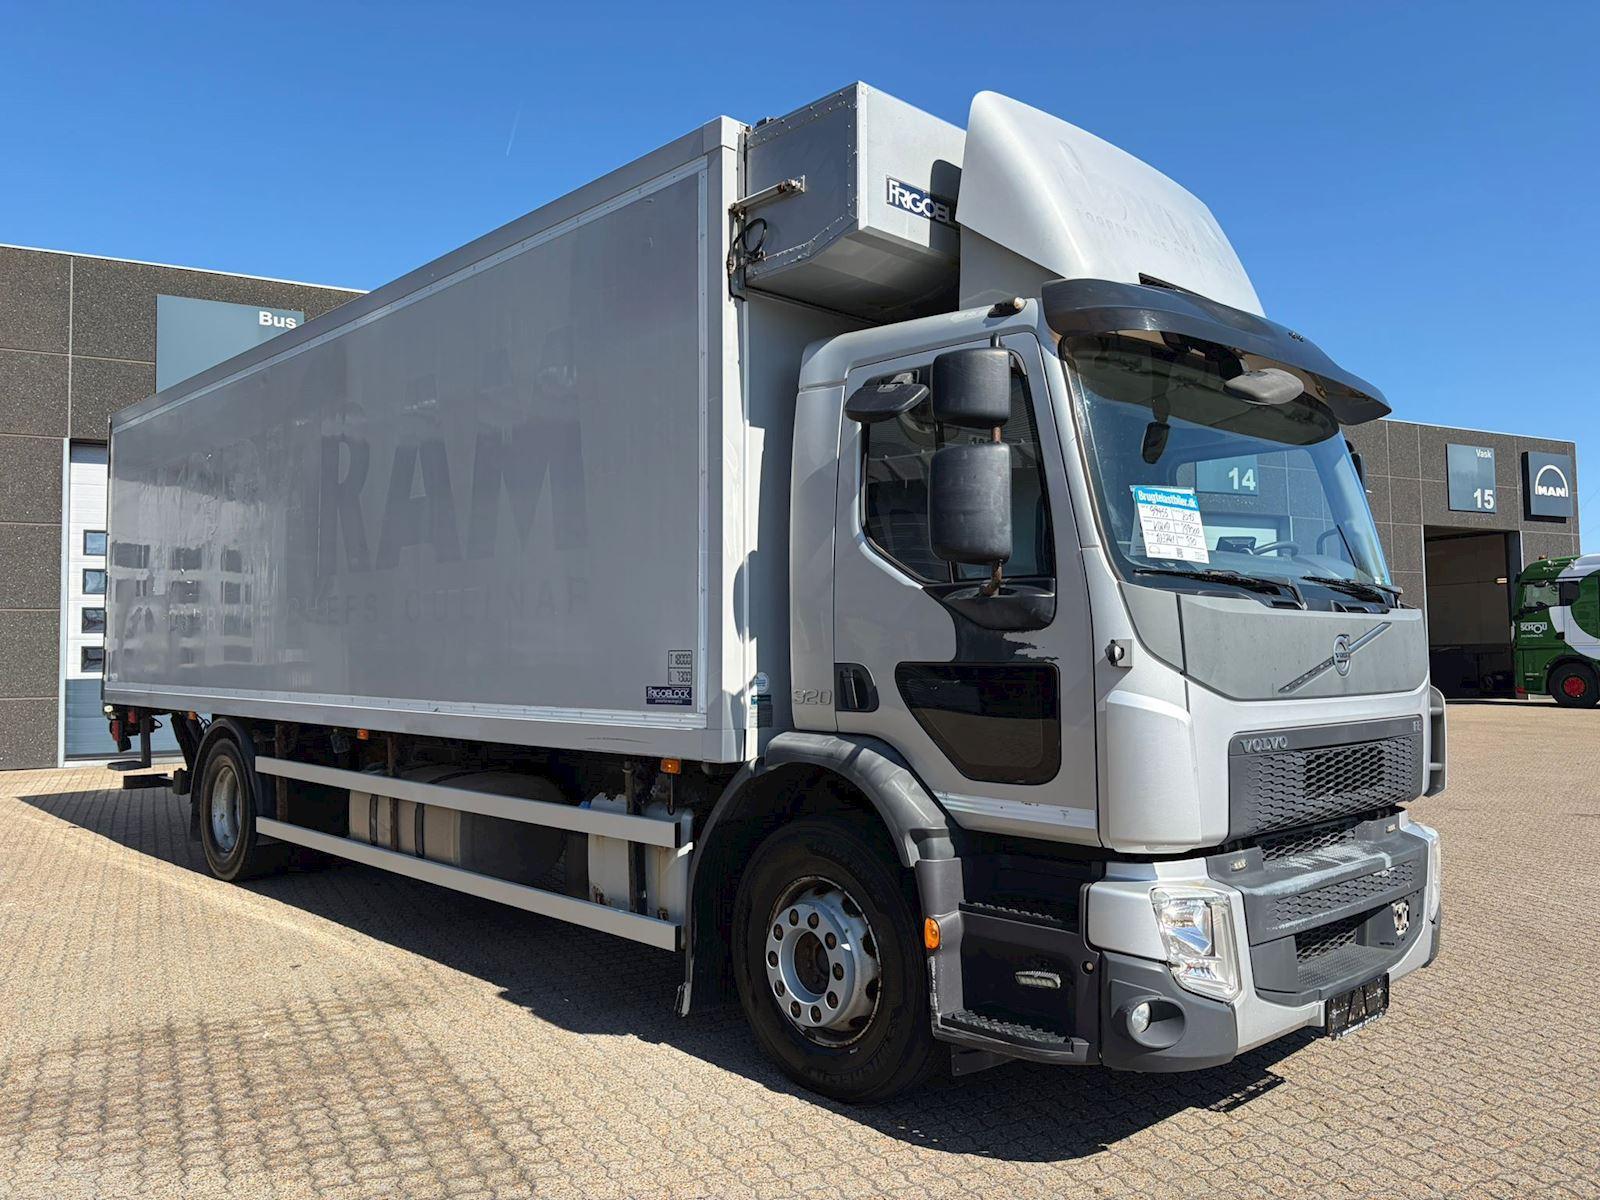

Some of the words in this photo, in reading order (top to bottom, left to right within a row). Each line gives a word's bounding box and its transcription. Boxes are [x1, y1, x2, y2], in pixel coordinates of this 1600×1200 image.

[259, 310, 297, 329] Bus
[1475, 449, 1492, 459] Vask
[1228, 467, 1256, 491] 14
[1473, 488, 1495, 510] 15
[1537, 486, 1565, 497] MAN
[1520, 622, 1548, 634] SCHOU
[793, 688, 833, 705] 320
[1239, 735, 1288, 753] VOLVO
